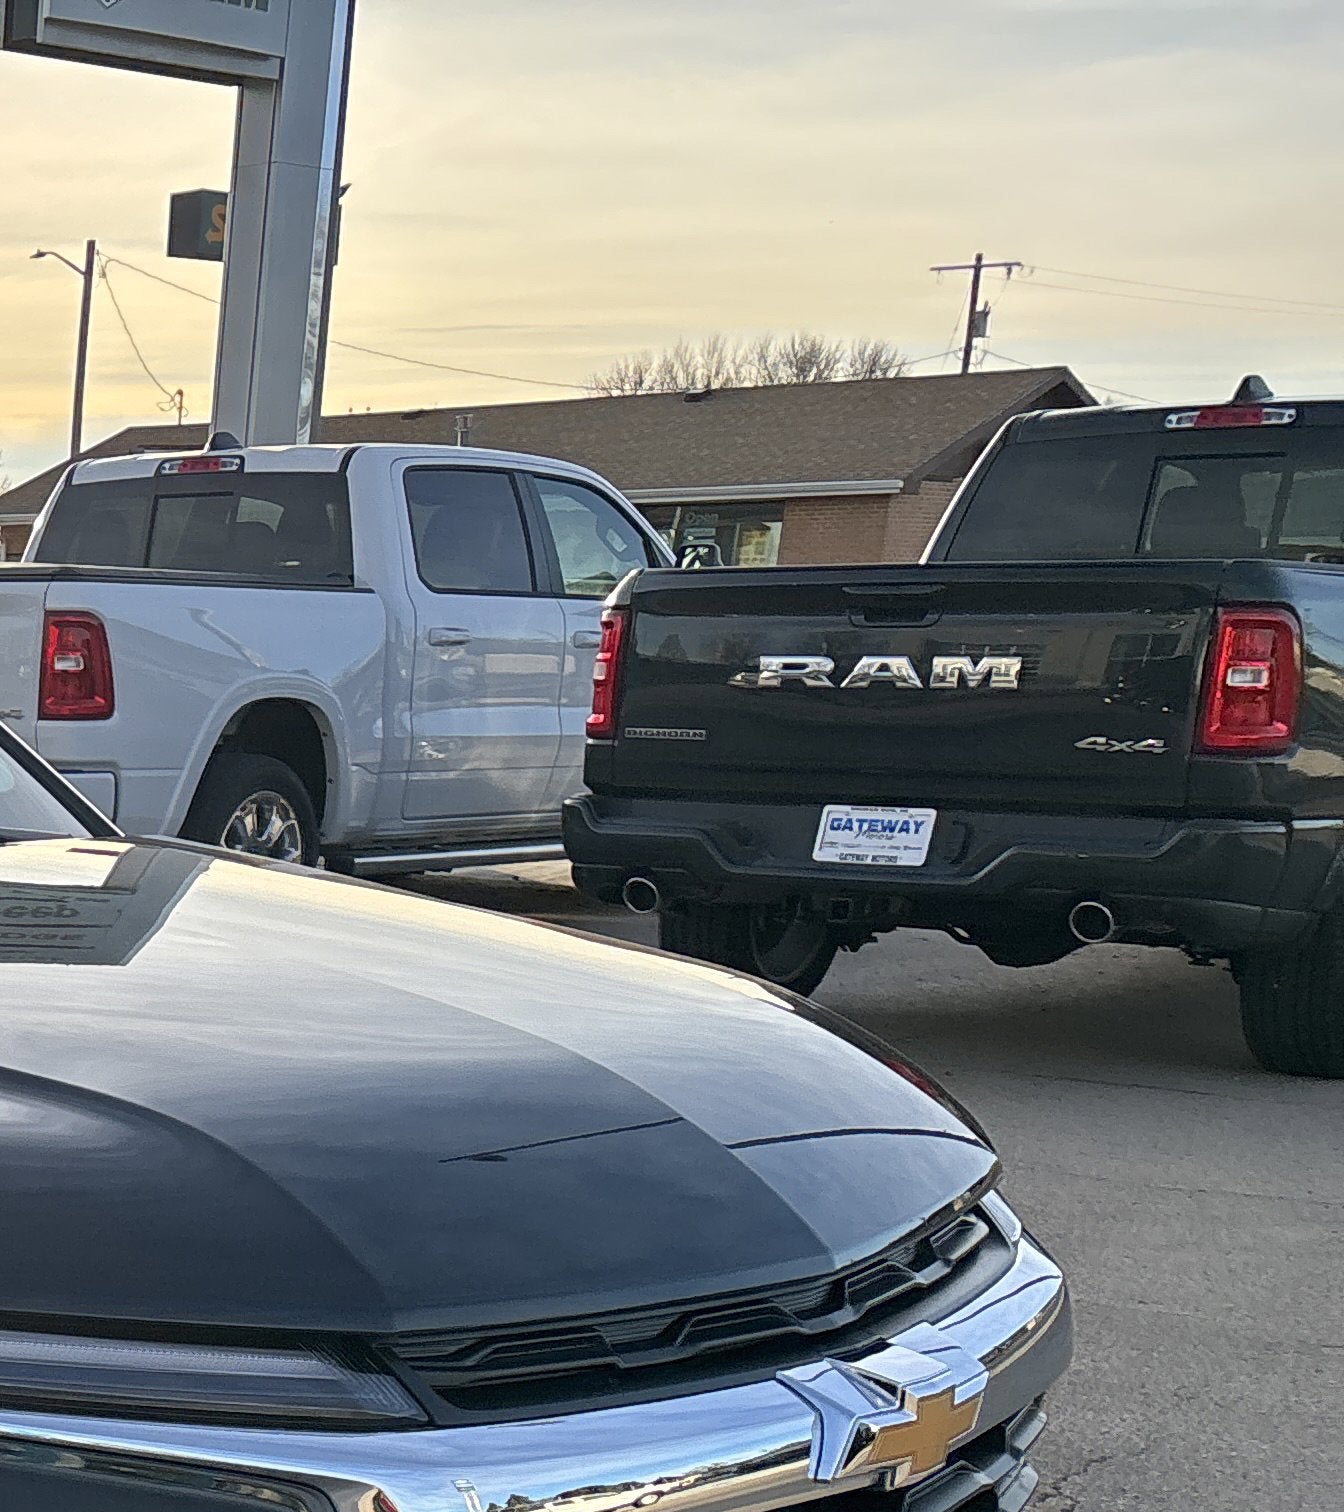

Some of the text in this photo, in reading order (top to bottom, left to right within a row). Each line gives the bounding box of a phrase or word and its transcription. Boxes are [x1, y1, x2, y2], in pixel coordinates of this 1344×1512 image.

[726, 655, 1023, 689] RAM
[1073, 736, 1169, 754] 4x4
[829, 817, 926, 835] GATEWAY
